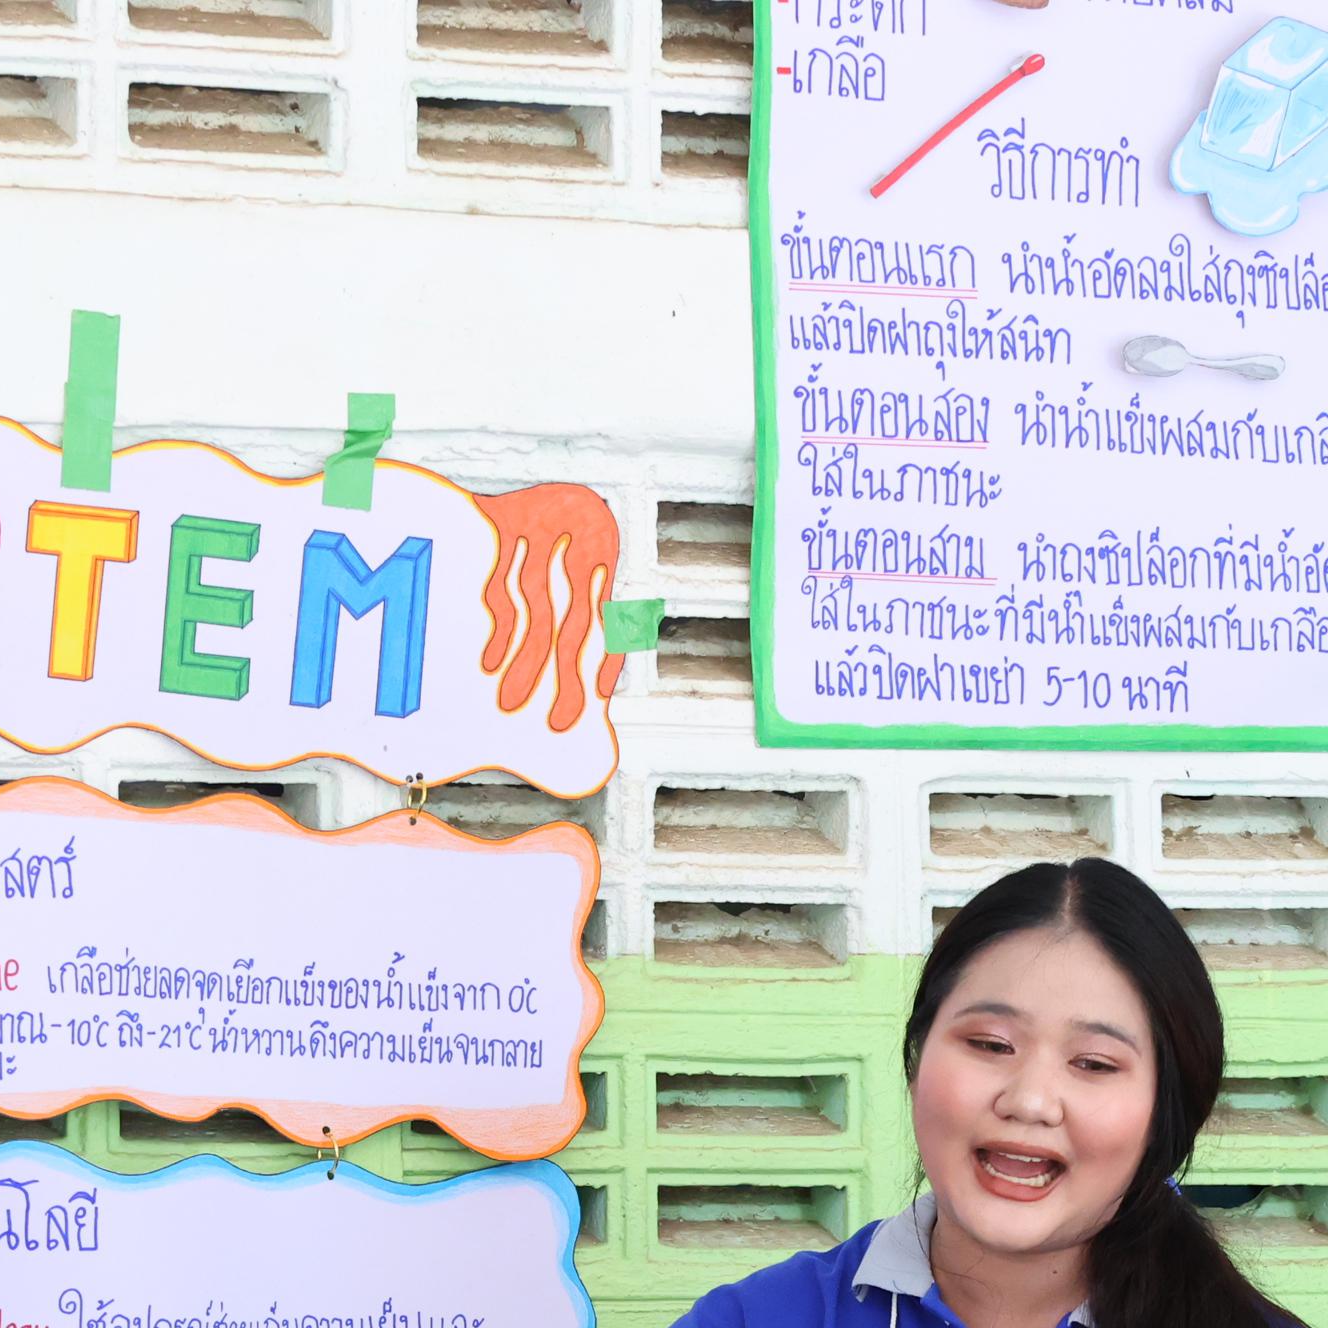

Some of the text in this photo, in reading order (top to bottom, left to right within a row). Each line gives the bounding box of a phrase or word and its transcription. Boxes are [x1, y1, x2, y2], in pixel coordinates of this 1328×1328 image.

[977, 117, 1139, 207] วิธีการทำ
[780, 210, 976, 289] ขั้นตอนแรก
[790, 299, 1071, 381] แล้วปิดฝาถุงให้สนิท
[793, 362, 990, 443] ขั้นตอนสอง
[798, 442, 1002, 508] ใส่ในภาชนะ
[801, 506, 985, 579] ขั้นตอนสาม
[1043, 666, 1112, 708] 5-10
[1122, 661, 1189, 713] นาที
